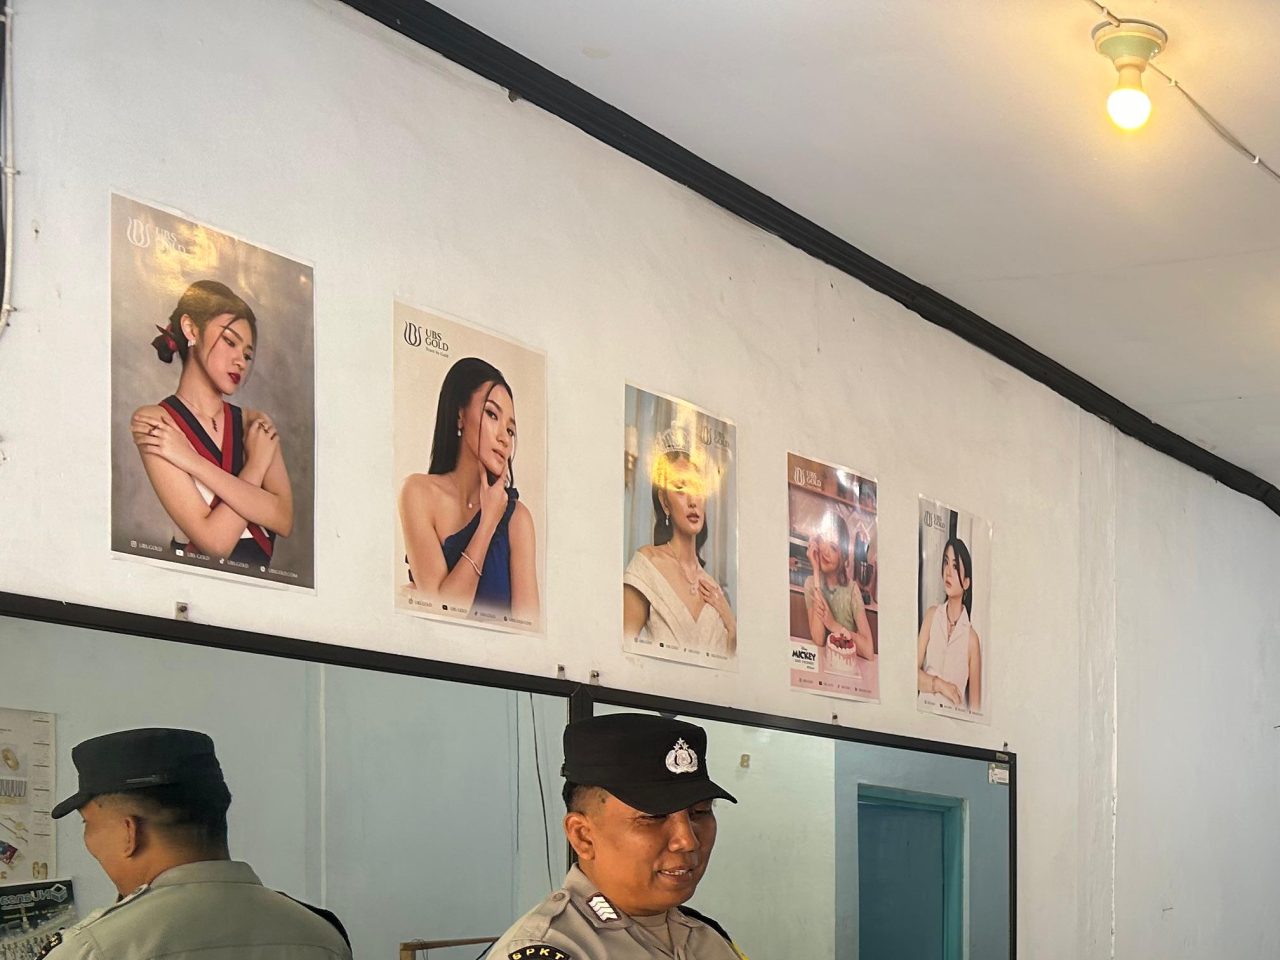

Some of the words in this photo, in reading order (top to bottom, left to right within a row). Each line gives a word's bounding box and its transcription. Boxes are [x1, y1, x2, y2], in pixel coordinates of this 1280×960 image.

[425, 328, 442, 341] UBS
[425, 337, 449, 352] GOLD
[791, 649, 817, 662] MICKEY
[512, 947, 565, 960] SPKT
